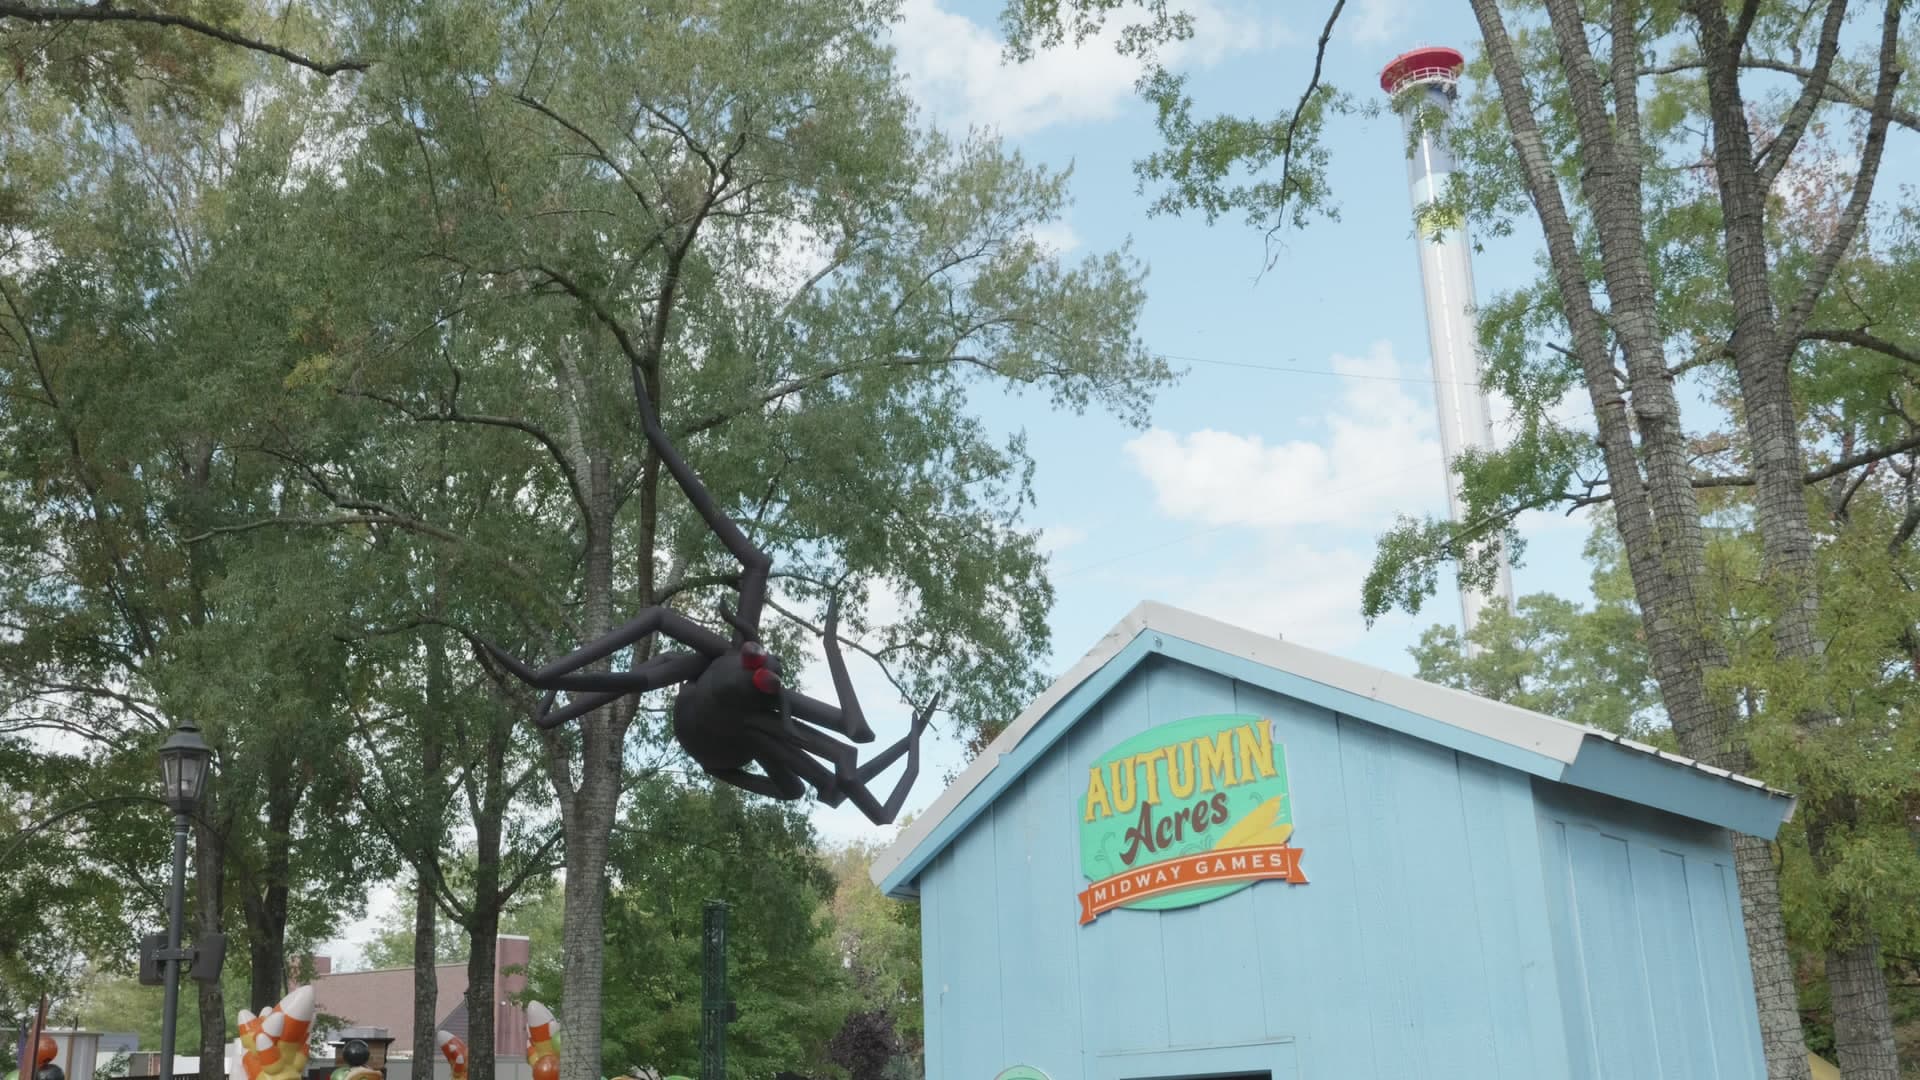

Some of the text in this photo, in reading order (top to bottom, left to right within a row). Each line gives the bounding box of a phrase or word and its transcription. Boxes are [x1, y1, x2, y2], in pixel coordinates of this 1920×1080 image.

[1084, 720, 1278, 822] AUTUMN
[1120, 792, 1228, 865] Acres
[1094, 854, 1282, 902] MIDWAY GAMES
